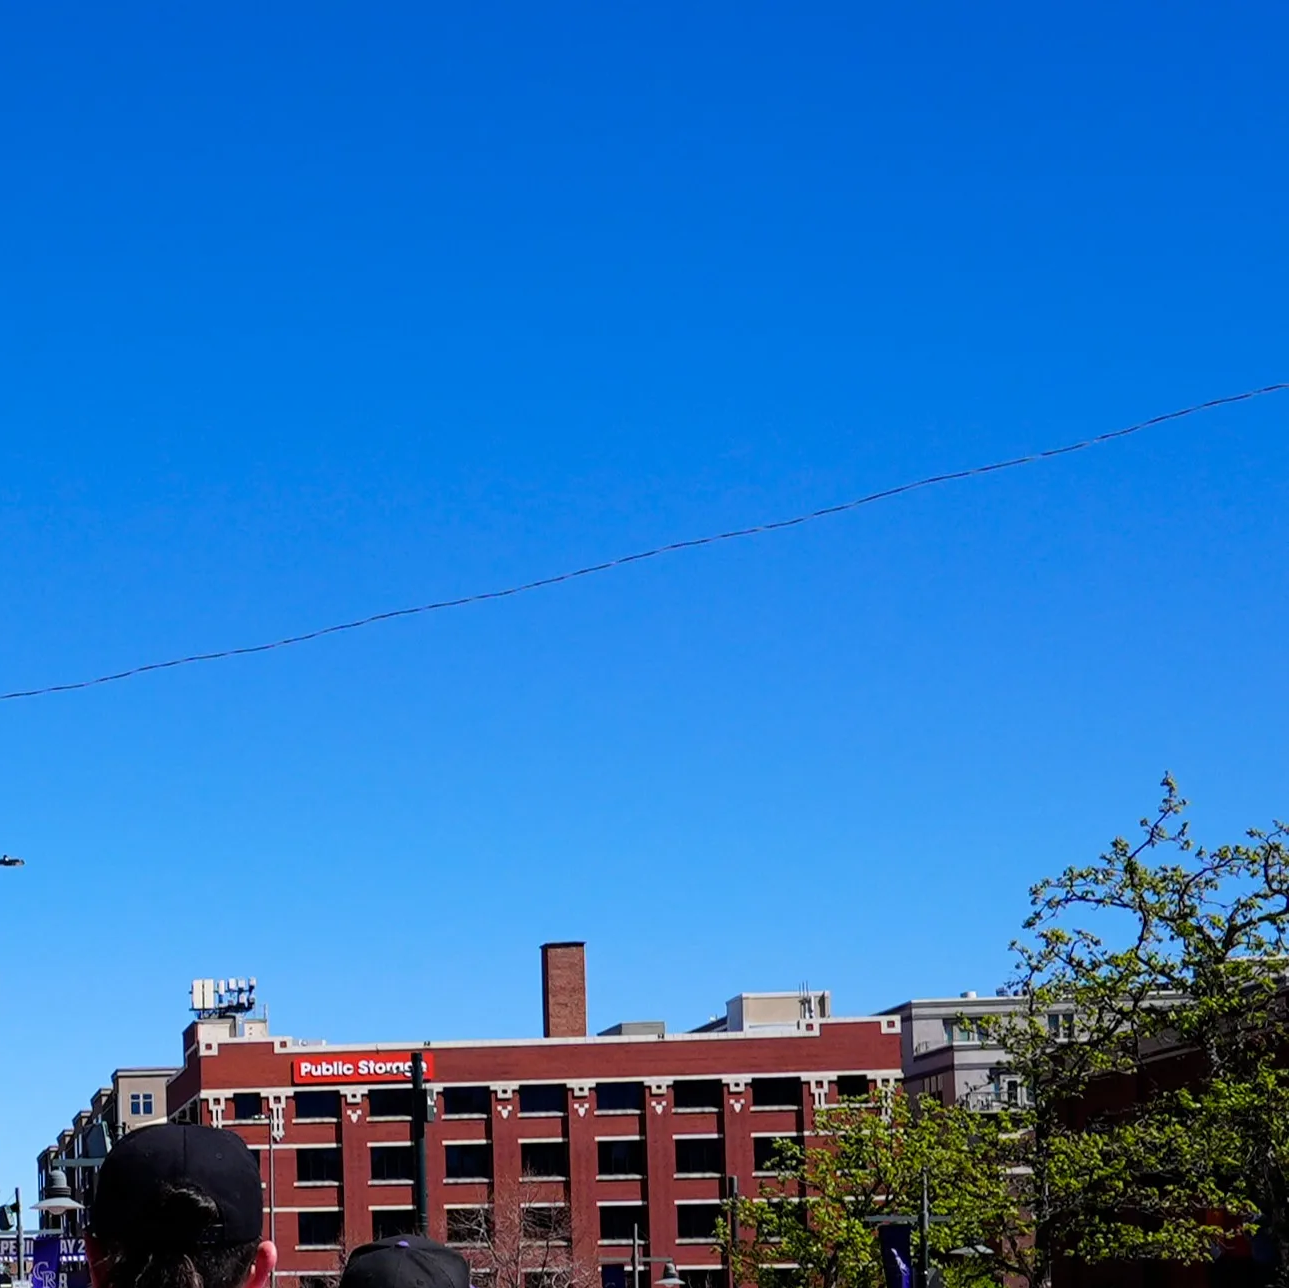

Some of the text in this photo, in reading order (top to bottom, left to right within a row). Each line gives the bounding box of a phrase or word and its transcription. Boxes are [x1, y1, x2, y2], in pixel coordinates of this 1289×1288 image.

[300, 1059, 427, 1076] Public Storag
[60, 1239, 76, 1254] AY
